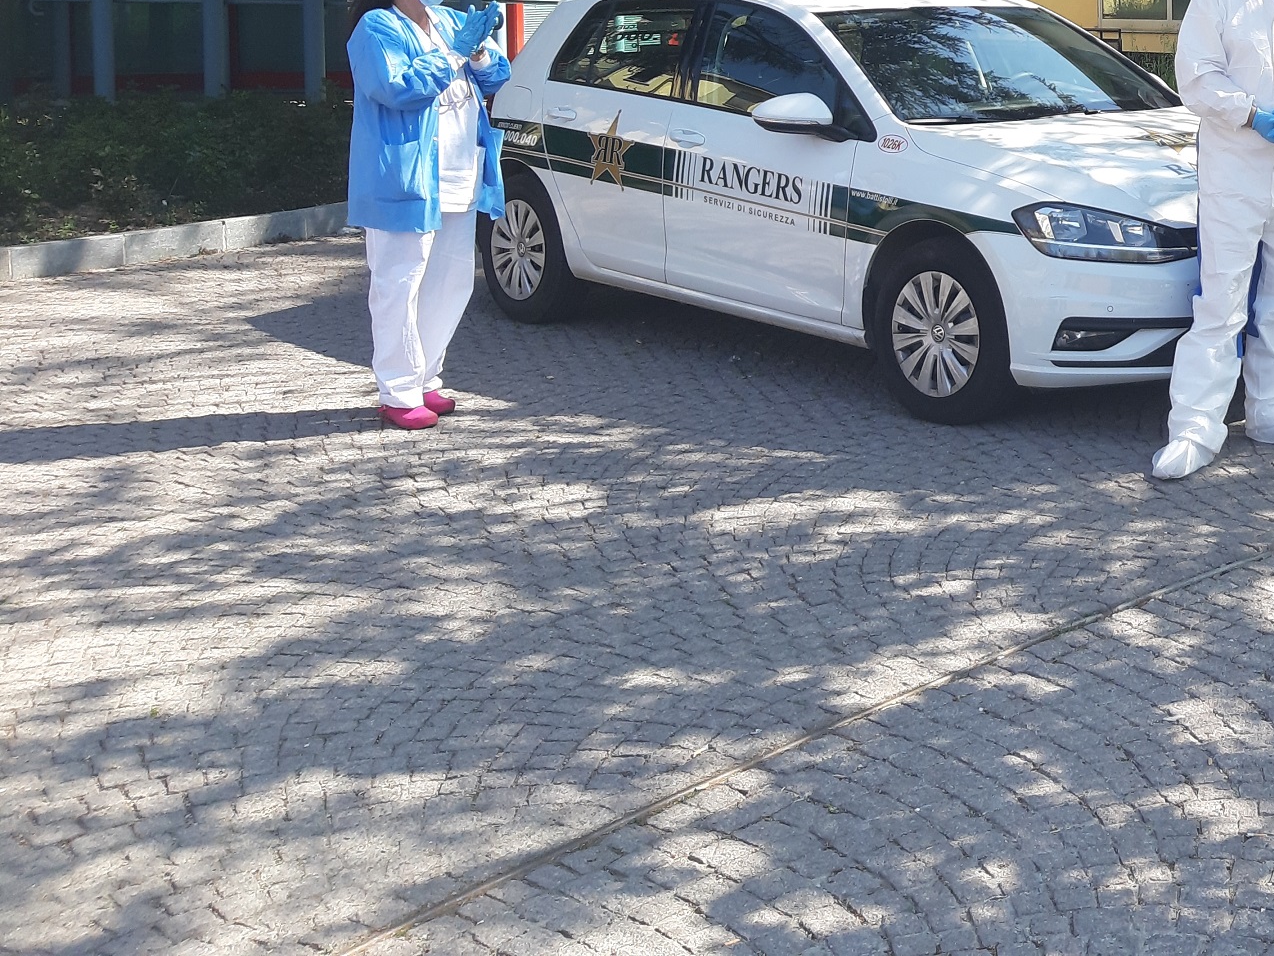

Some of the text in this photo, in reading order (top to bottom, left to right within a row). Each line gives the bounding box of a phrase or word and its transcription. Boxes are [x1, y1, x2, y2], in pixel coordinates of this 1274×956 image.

[880, 137, 905, 151] 1026K
[698, 155, 804, 205] RANGERS
[703, 195, 796, 227] SERVIZI DI SICUREZZA
